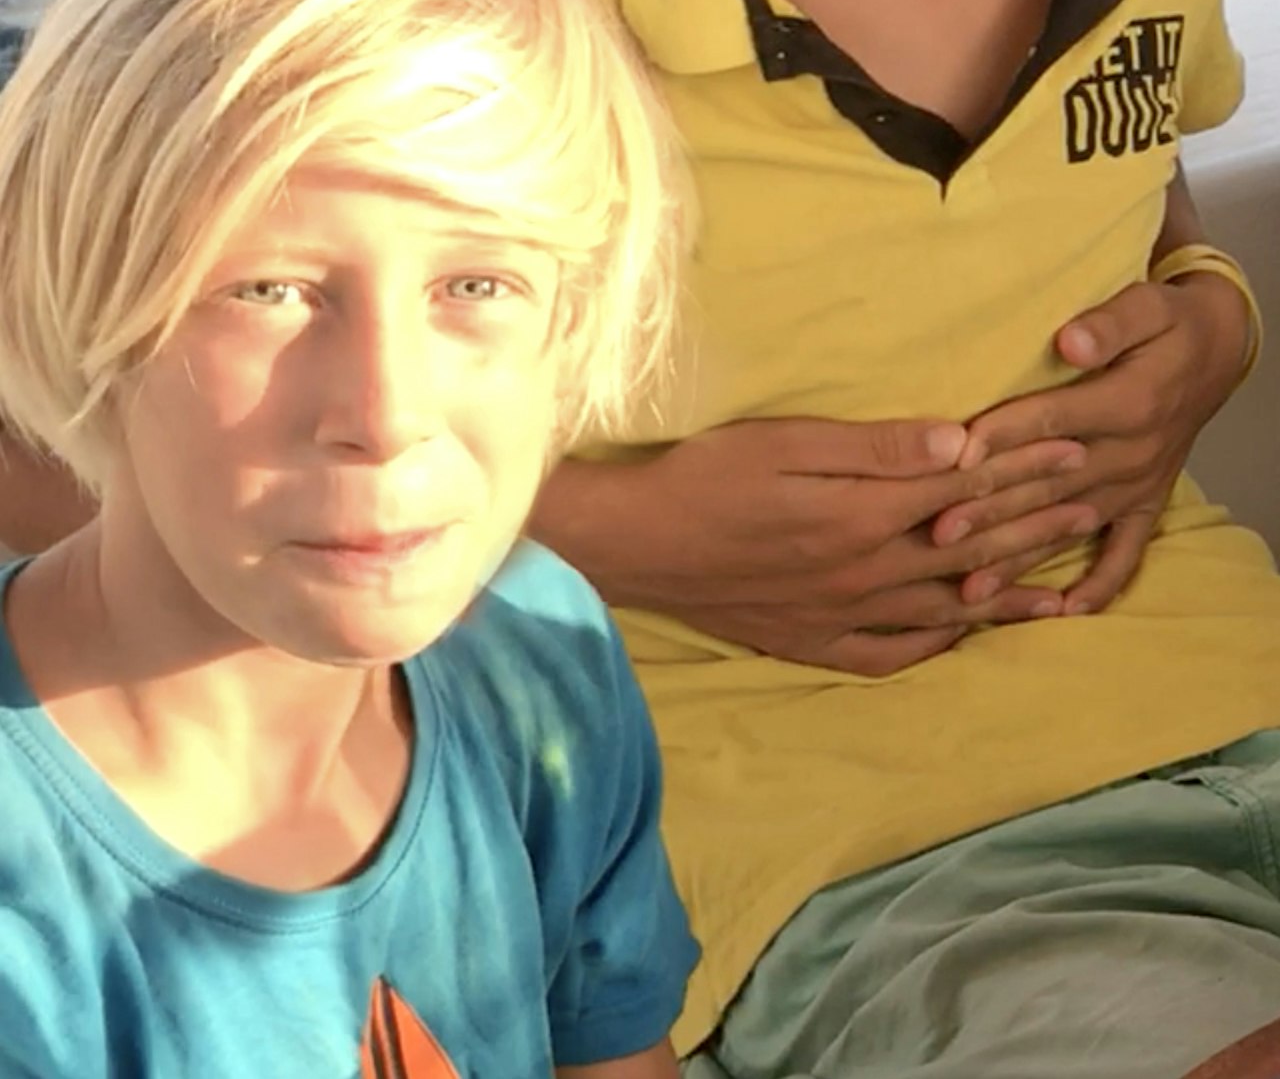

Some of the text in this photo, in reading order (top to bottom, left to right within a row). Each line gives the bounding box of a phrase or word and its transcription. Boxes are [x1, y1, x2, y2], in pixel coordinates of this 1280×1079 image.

[1096, 21, 1182, 77] ET IT
[1064, 73, 1176, 164] DUDE
